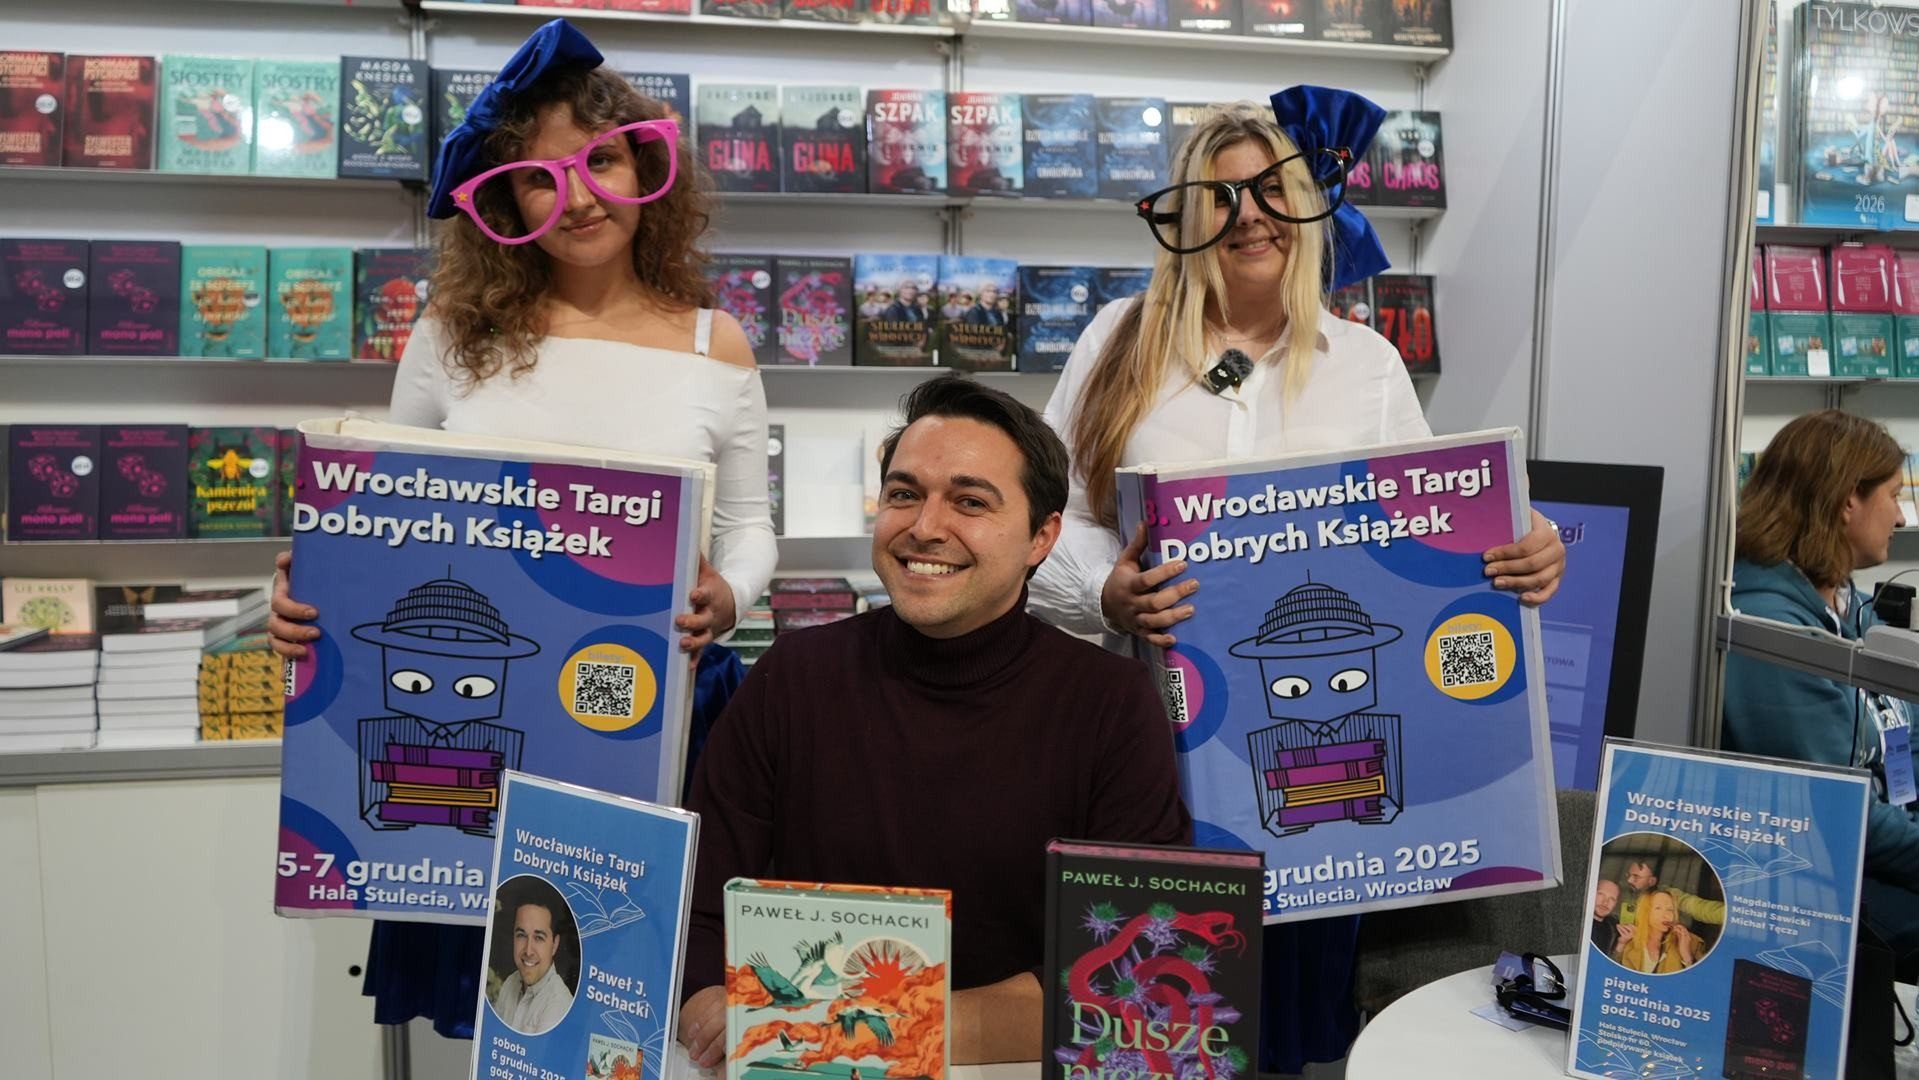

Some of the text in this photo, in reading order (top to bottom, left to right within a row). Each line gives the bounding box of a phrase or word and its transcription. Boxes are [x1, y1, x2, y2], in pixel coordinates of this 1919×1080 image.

[360, 61, 411, 72] MAGDA
[875, 102, 938, 123] SZPAK
[950, 105, 1013, 126] SZPAK
[709, 139, 771, 171] GLINA
[793, 141, 856, 173] GLINA
[1384, 160, 1440, 190] CHAOS
[1855, 194, 1885, 213] 2026
[196, 485, 267, 497] Kamienica
[312, 460, 662, 525] Wrocławskie Targi
[1174, 472, 1399, 523] Wrocławskie
[1404, 459, 1492, 497] Targi
[21, 513, 83, 525] mono poli
[111, 512, 173, 525] mono poli
[293, 502, 613, 559] Dobrych Książek
[1160, 506, 1453, 565] Dobrych Książek
[1543, 656, 1575, 668] TOWA
[1627, 791, 1810, 833] Wrocławskie Targi
[1625, 809, 1786, 848] Dobrych Książek
[516, 828, 645, 878] Wrocławskie Targi
[1264, 839, 1481, 895] grudnia 2025
[278, 852, 485, 887] 5-7 grudnia
[514, 848, 628, 893] Dobrych Książek
[1062, 871, 1247, 896] PAWEŁ J. SOCHACKI
[309, 885, 359, 901] Hala
[365, 886, 456, 910] Stulecia,
[1277, 889, 1361, 910] Stulecia,
[1365, 876, 1453, 898] Wrocław
[741, 904, 929, 929] PAWEŁ J. SOCHACKI
[1730, 917, 1766, 930] Michał
[1732, 905, 1811, 928] Michał Sawicki
[1733, 895, 1852, 924] Magdalena Kuszewska
[589, 965, 648, 997] Paweł J.
[1604, 976, 1650, 994] piątek
[586, 985, 650, 1019] Sochacki
[1600, 1003, 1681, 1029] godz. 18:00
[1602, 989, 1711, 1022] 5 grudnia 2025
[1071, 1002, 1229, 1057] Dusze
[1651, 1034, 1688, 1047] Wrocław
[493, 1036, 526, 1057] sobota
[491, 1049, 498, 1060] 6
[500, 1054, 538, 1077] grudnia
